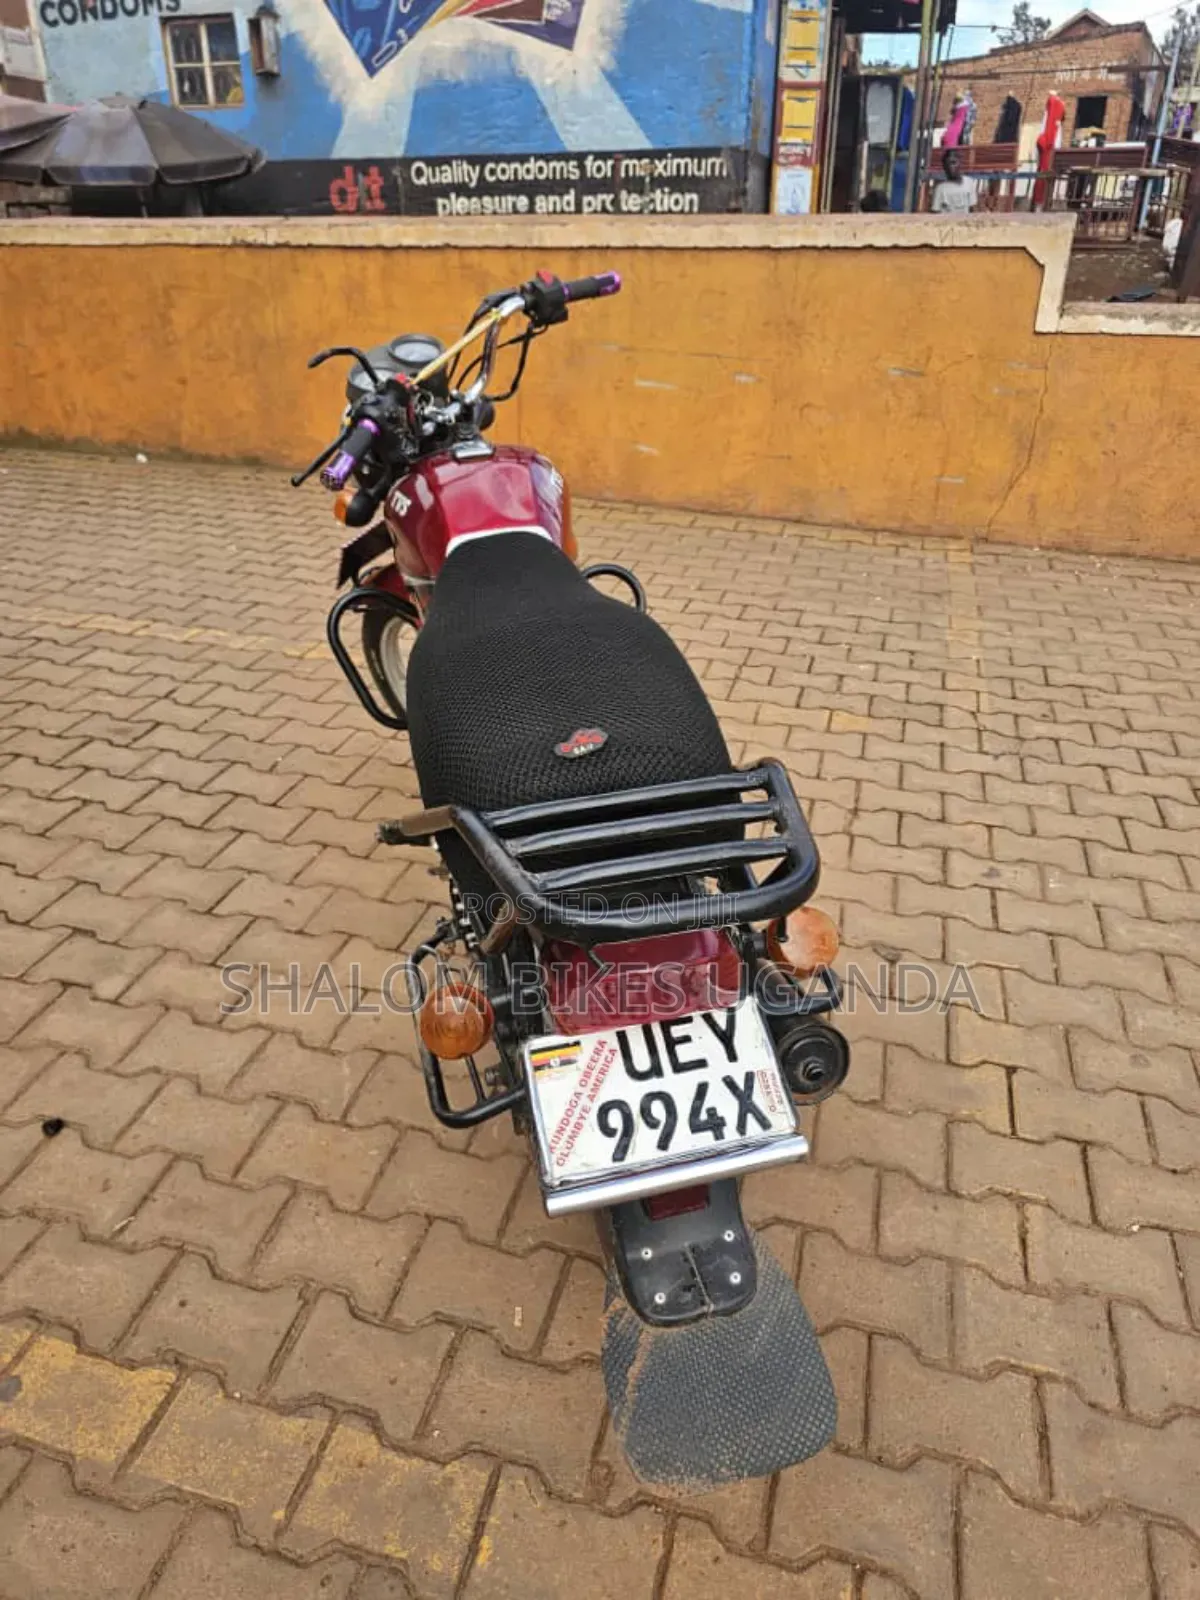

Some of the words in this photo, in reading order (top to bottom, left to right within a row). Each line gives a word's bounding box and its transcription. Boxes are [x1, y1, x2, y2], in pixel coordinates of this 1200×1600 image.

[410, 159, 480, 188] Quality
[484, 156, 580, 182] condoms
[585, 154, 615, 179] for
[436, 191, 529, 216] pleasure
[535, 187, 576, 213] and
[615, 1007, 738, 1082] UEY
[587, 1047, 618, 1103] AMERICA
[596, 1071, 772, 1163] 994X
